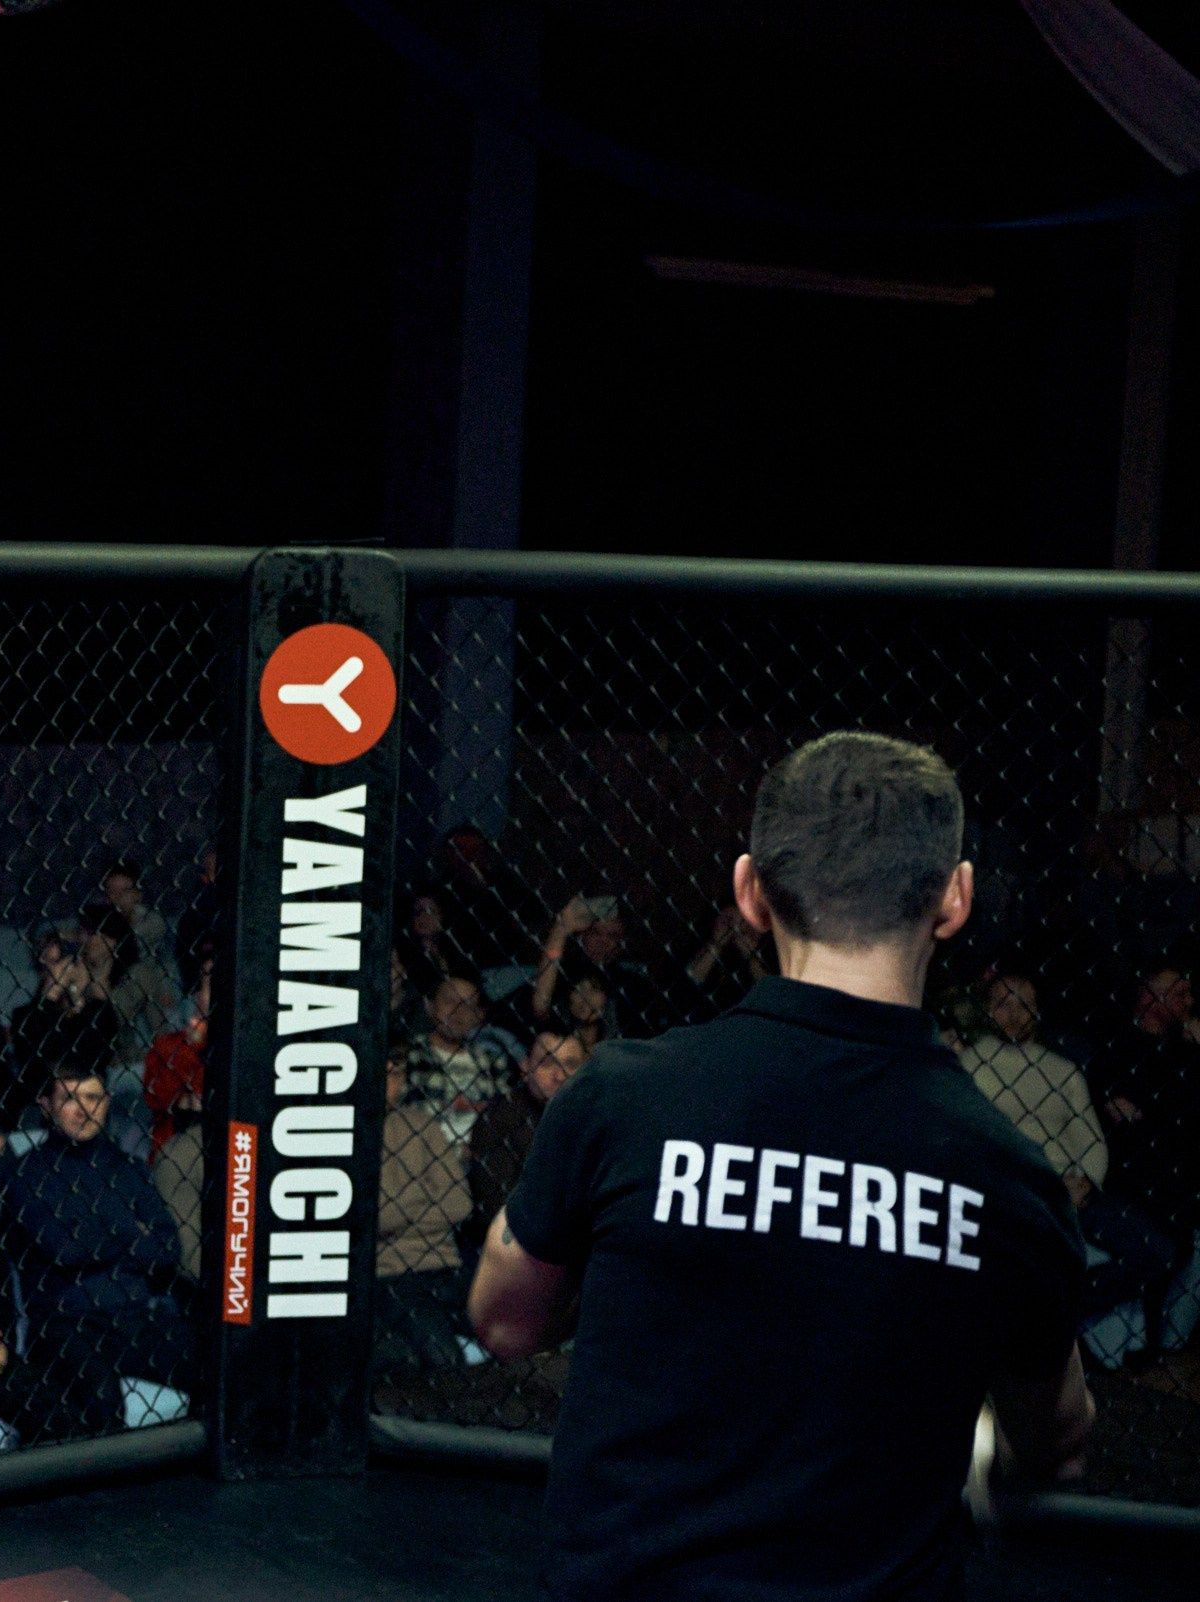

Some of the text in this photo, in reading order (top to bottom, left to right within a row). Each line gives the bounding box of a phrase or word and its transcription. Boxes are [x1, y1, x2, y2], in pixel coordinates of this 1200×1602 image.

[266, 784, 368, 1319] YAMAGUCHI
[227, 1130, 252, 1315] #ЯМОГУЧИЙ
[653, 1139, 985, 1272] REFEREE
